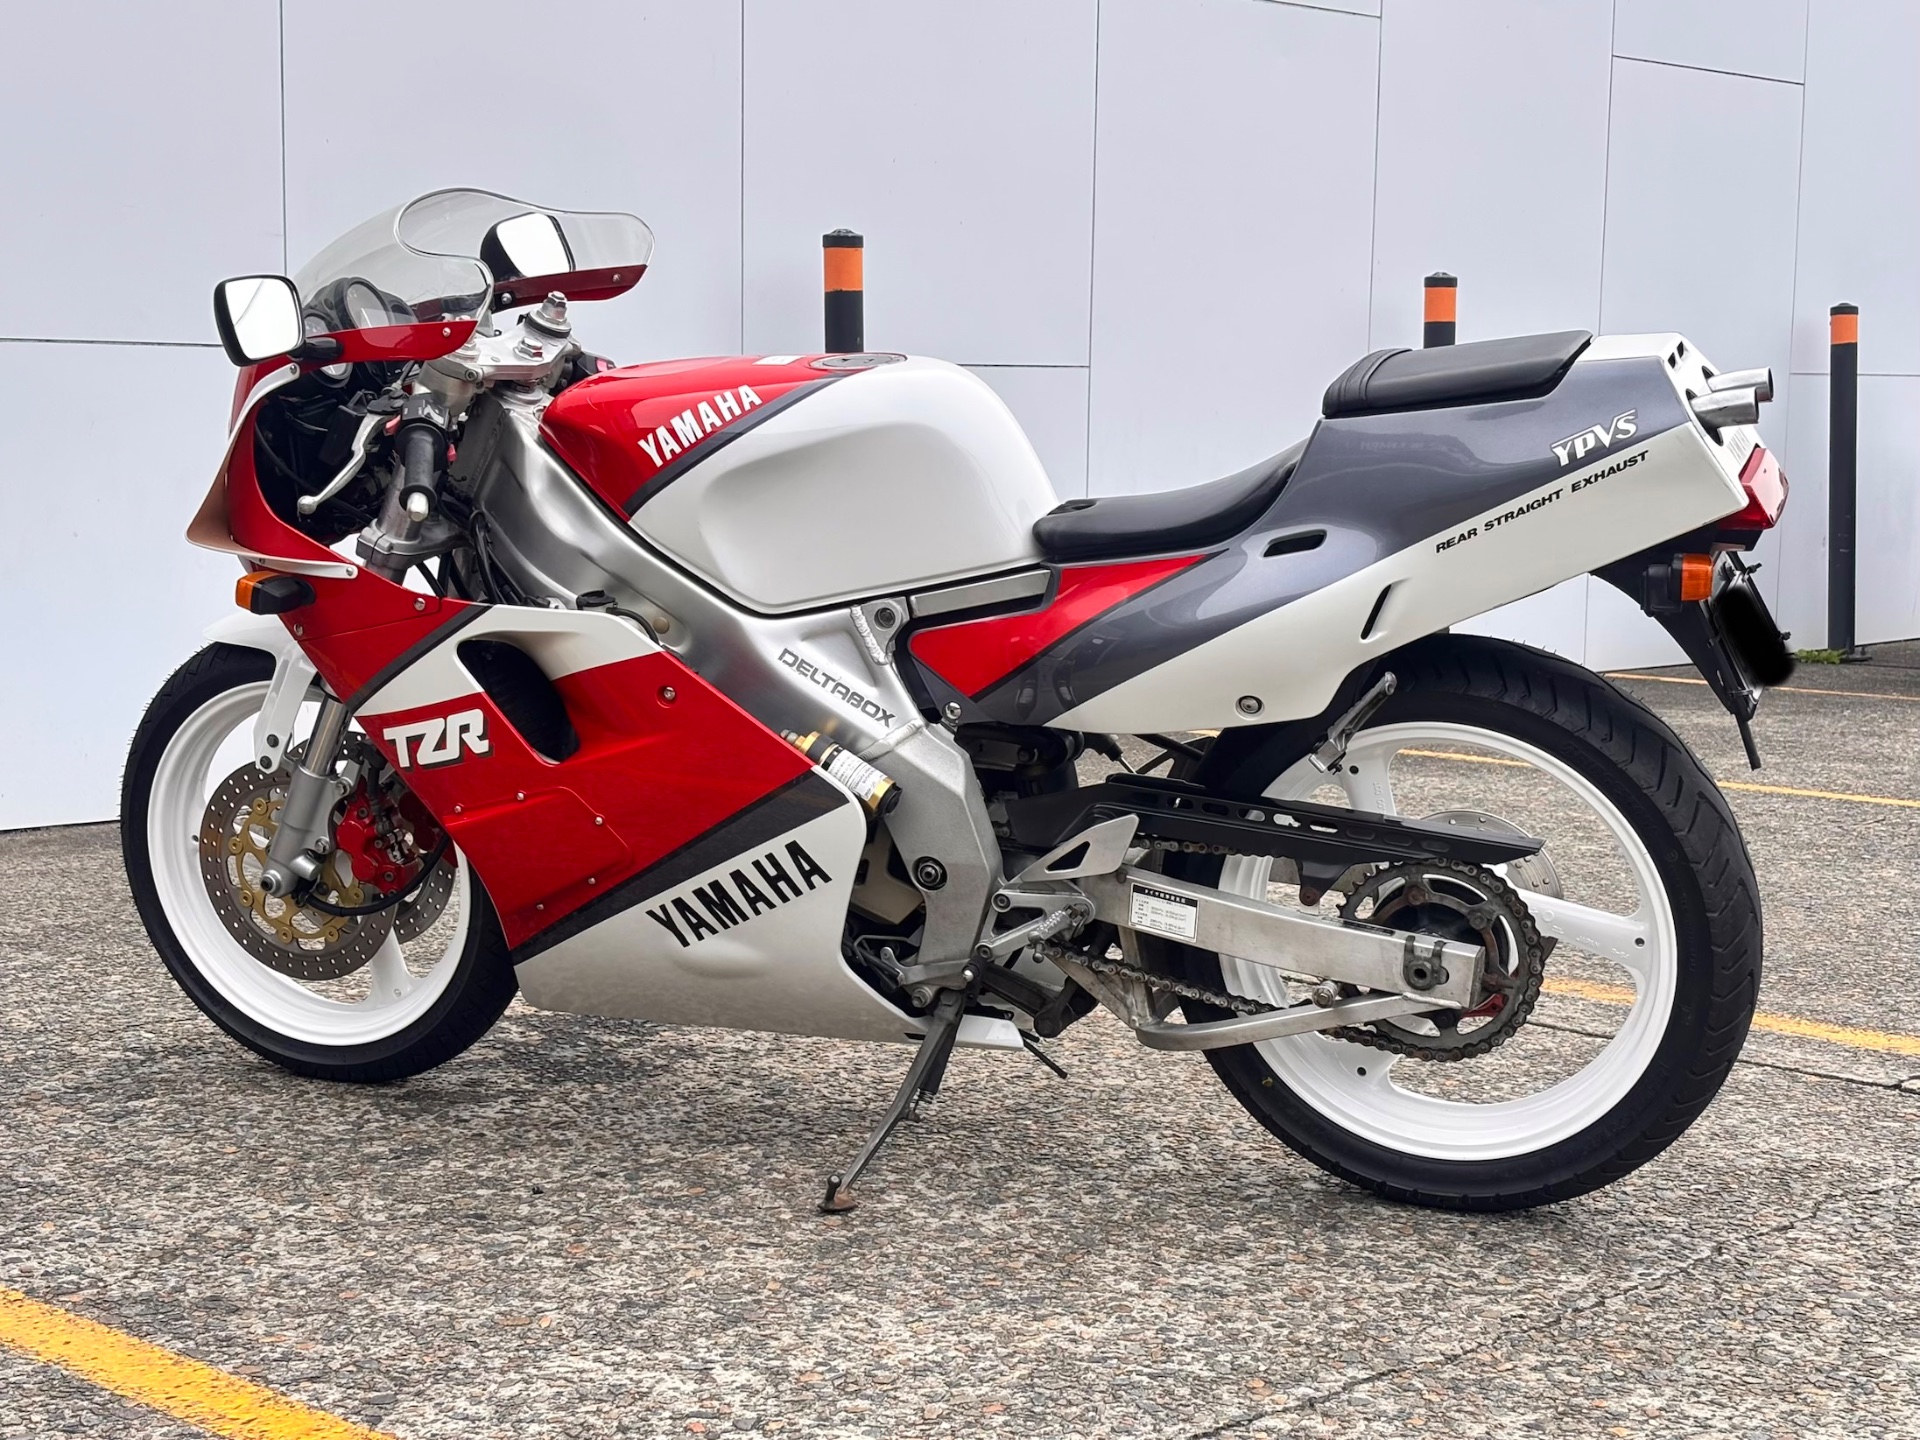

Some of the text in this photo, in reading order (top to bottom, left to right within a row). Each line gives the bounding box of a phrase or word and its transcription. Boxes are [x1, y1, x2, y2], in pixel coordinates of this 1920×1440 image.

[637, 384, 762, 468] YAMAHA
[1551, 409, 1637, 467] YPVS
[1436, 450, 1649, 553] REAR STRAIGHT EXHAUST
[778, 648, 896, 728] DELTABOX
[383, 708, 492, 770] TZR
[645, 839, 833, 948] YAMAHA
